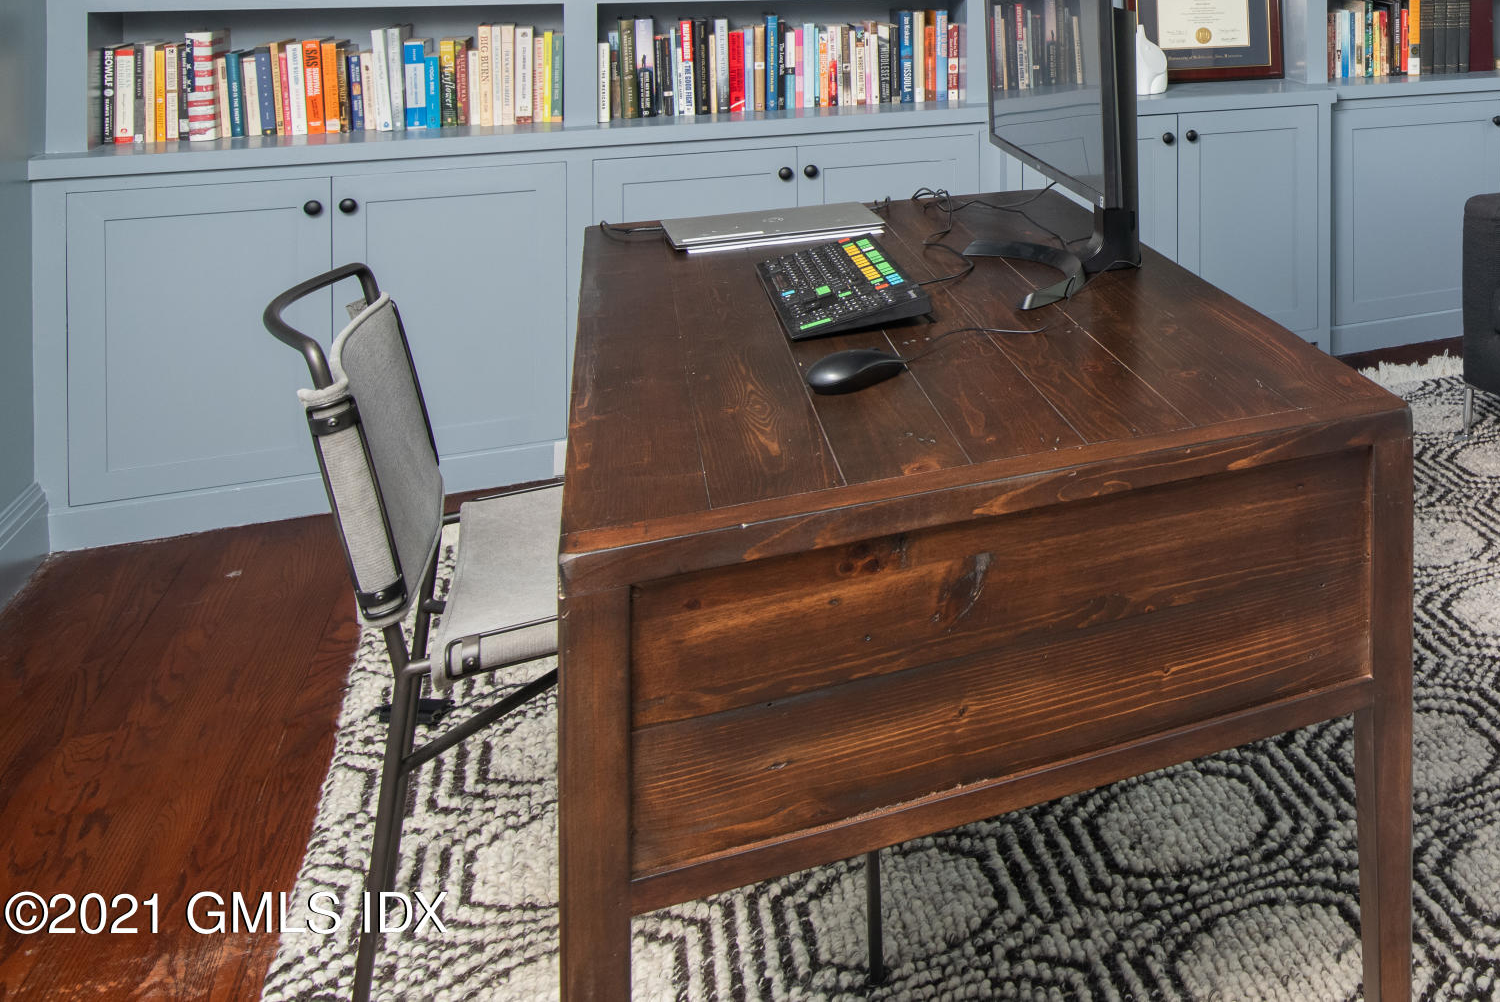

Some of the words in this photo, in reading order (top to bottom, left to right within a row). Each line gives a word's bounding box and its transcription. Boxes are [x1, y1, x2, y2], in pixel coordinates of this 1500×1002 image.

[480, 36, 489, 53] BIG
[682, 23, 690, 40] RALPH
[305, 49, 318, 68] SAS
[683, 41, 691, 59] NADER
[880, 47, 889, 81] MIDDLESEX
[105, 50, 114, 87] BEOWULF
[306, 68, 314, 97] HANDBOOK
[312, 67, 320, 96] SURVIVAL
[441, 55, 456, 109] Mayflower
[481, 56, 489, 83] BURN
[903, 61, 912, 93] MISSOULA
[233, 108, 241, 125] ENEMY
